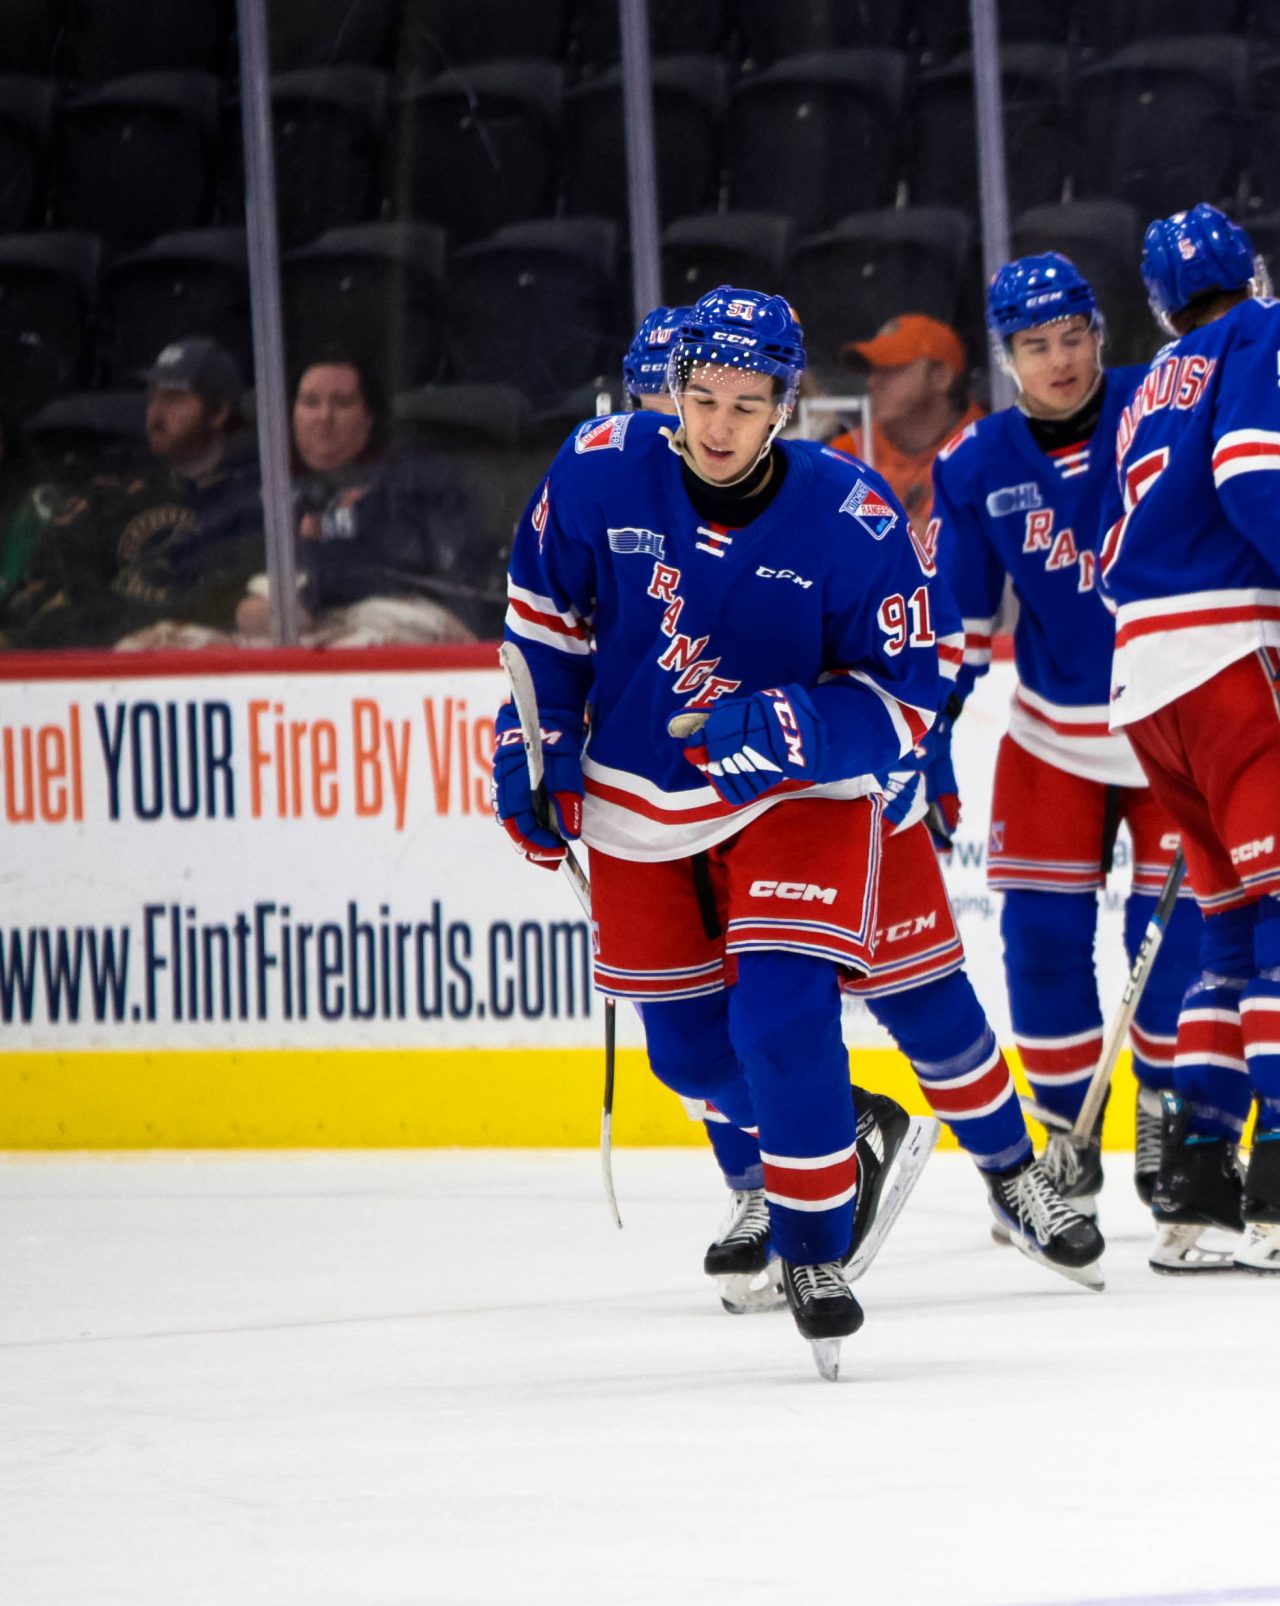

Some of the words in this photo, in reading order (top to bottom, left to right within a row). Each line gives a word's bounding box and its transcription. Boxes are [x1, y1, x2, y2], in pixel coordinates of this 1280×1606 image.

[1178, 237, 1197, 261] 5
[712, 331, 757, 347] CCM
[755, 565, 813, 589] CCM
[876, 584, 936, 657] 91
[495, 727, 563, 747] CM
[95, 701, 235, 821] YOUR
[248, 699, 338, 818] Fire
[352, 698, 411, 831] By
[424, 697, 511, 818] Vis
[749, 880, 838, 905] CCM
[0, 900, 591, 1024] www.FlintFirebirds.com
[1122, 934, 1153, 1005] CCM
